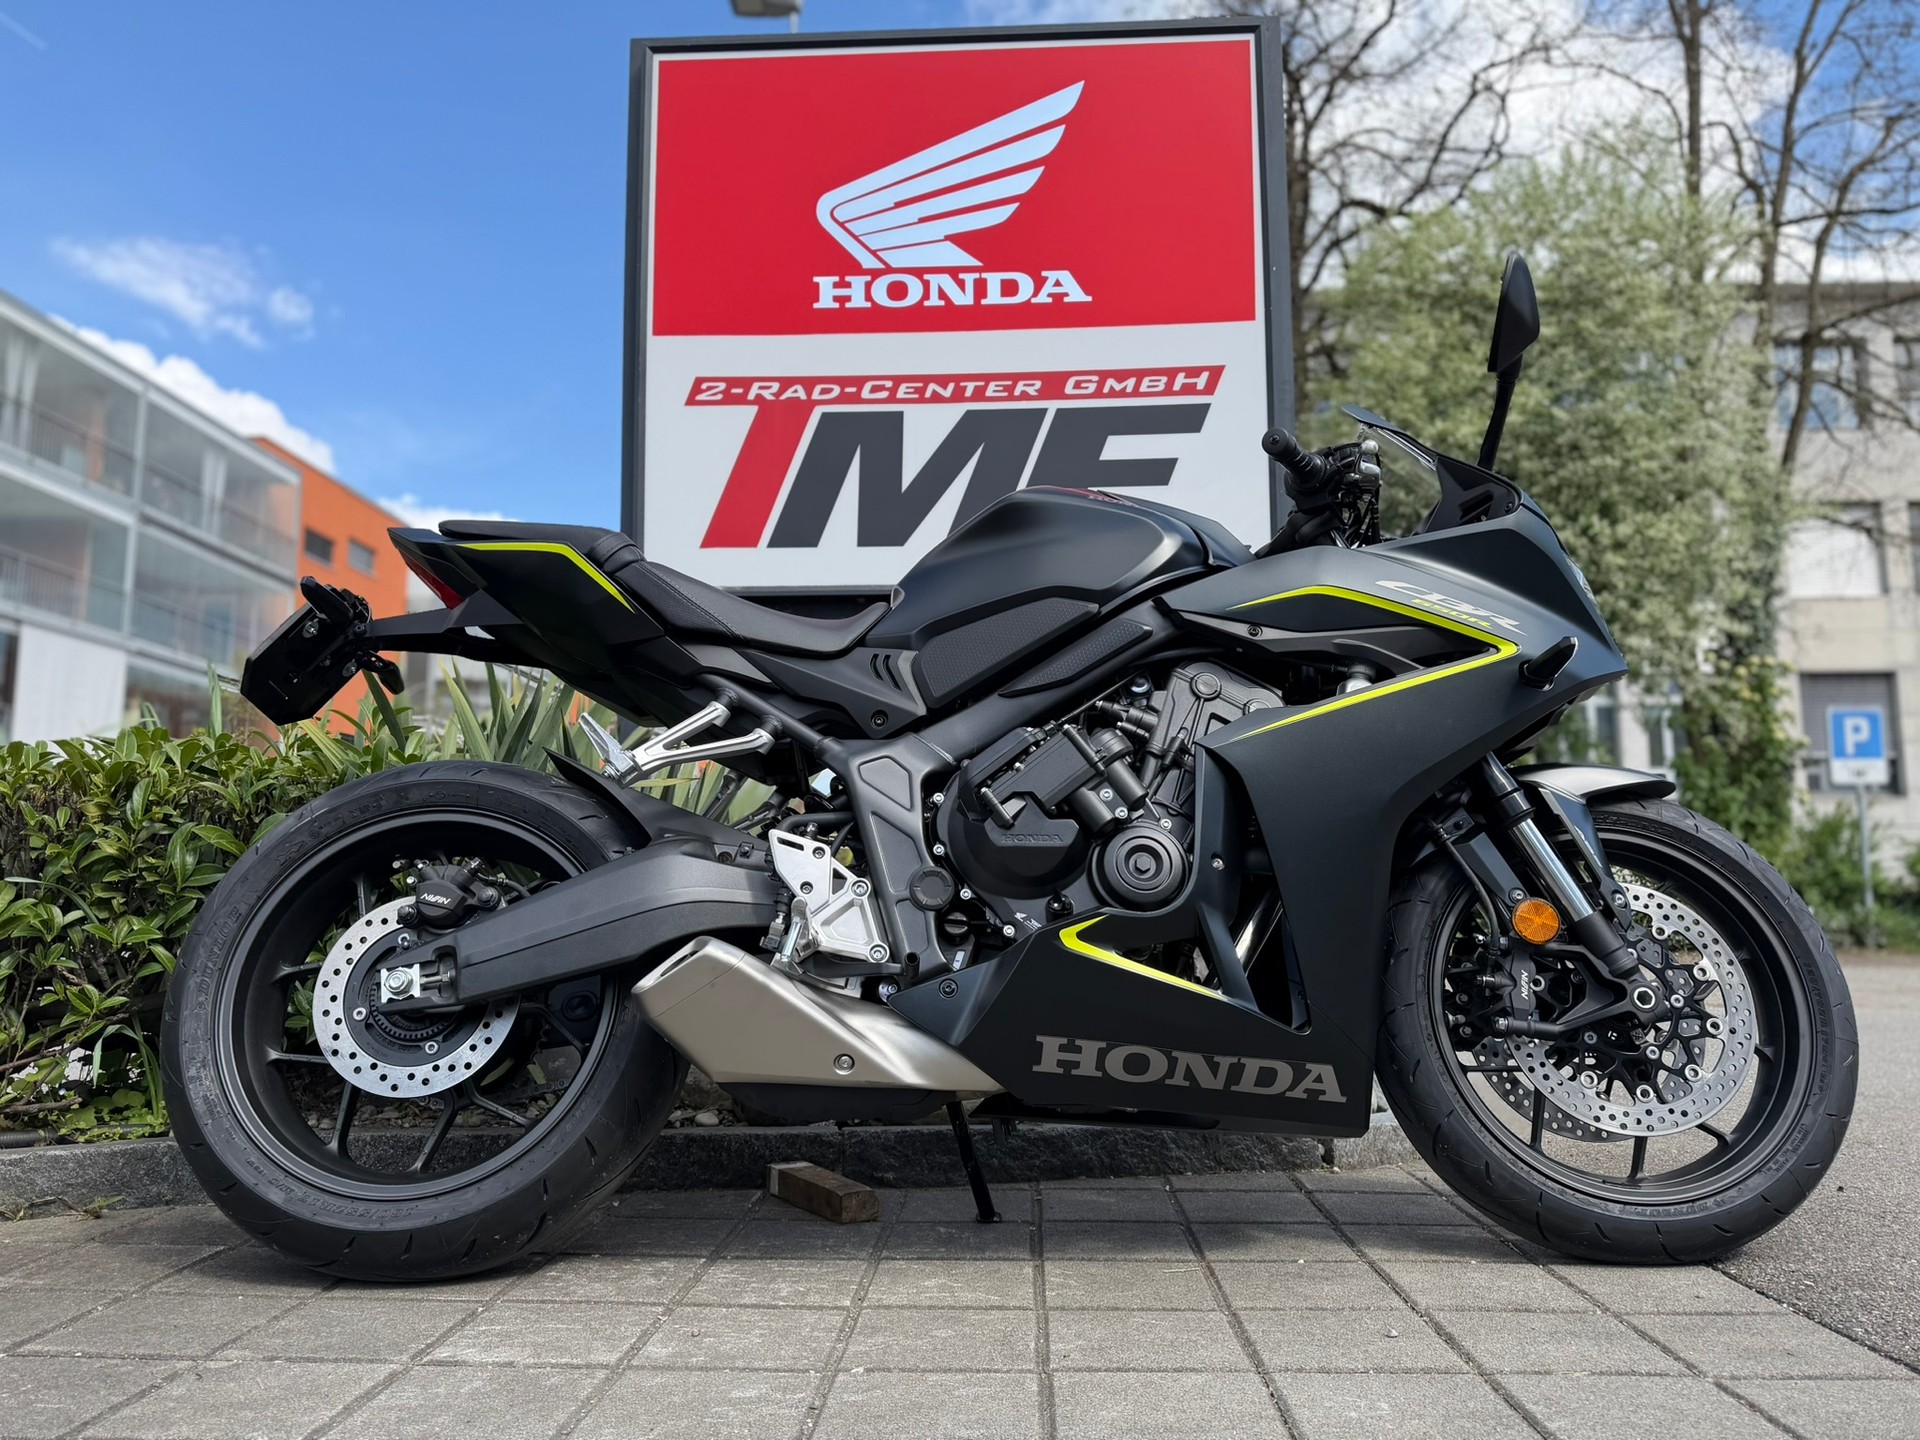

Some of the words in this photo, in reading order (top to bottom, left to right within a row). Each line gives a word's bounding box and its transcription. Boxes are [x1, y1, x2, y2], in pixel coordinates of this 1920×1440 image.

[813, 270, 1093, 309] HONDA
[1374, 580, 1529, 637] CBR
[1844, 716, 1871, 756] P
[1001, 833, 1064, 844] HONDA
[1032, 1034, 1348, 1104] HONDA
